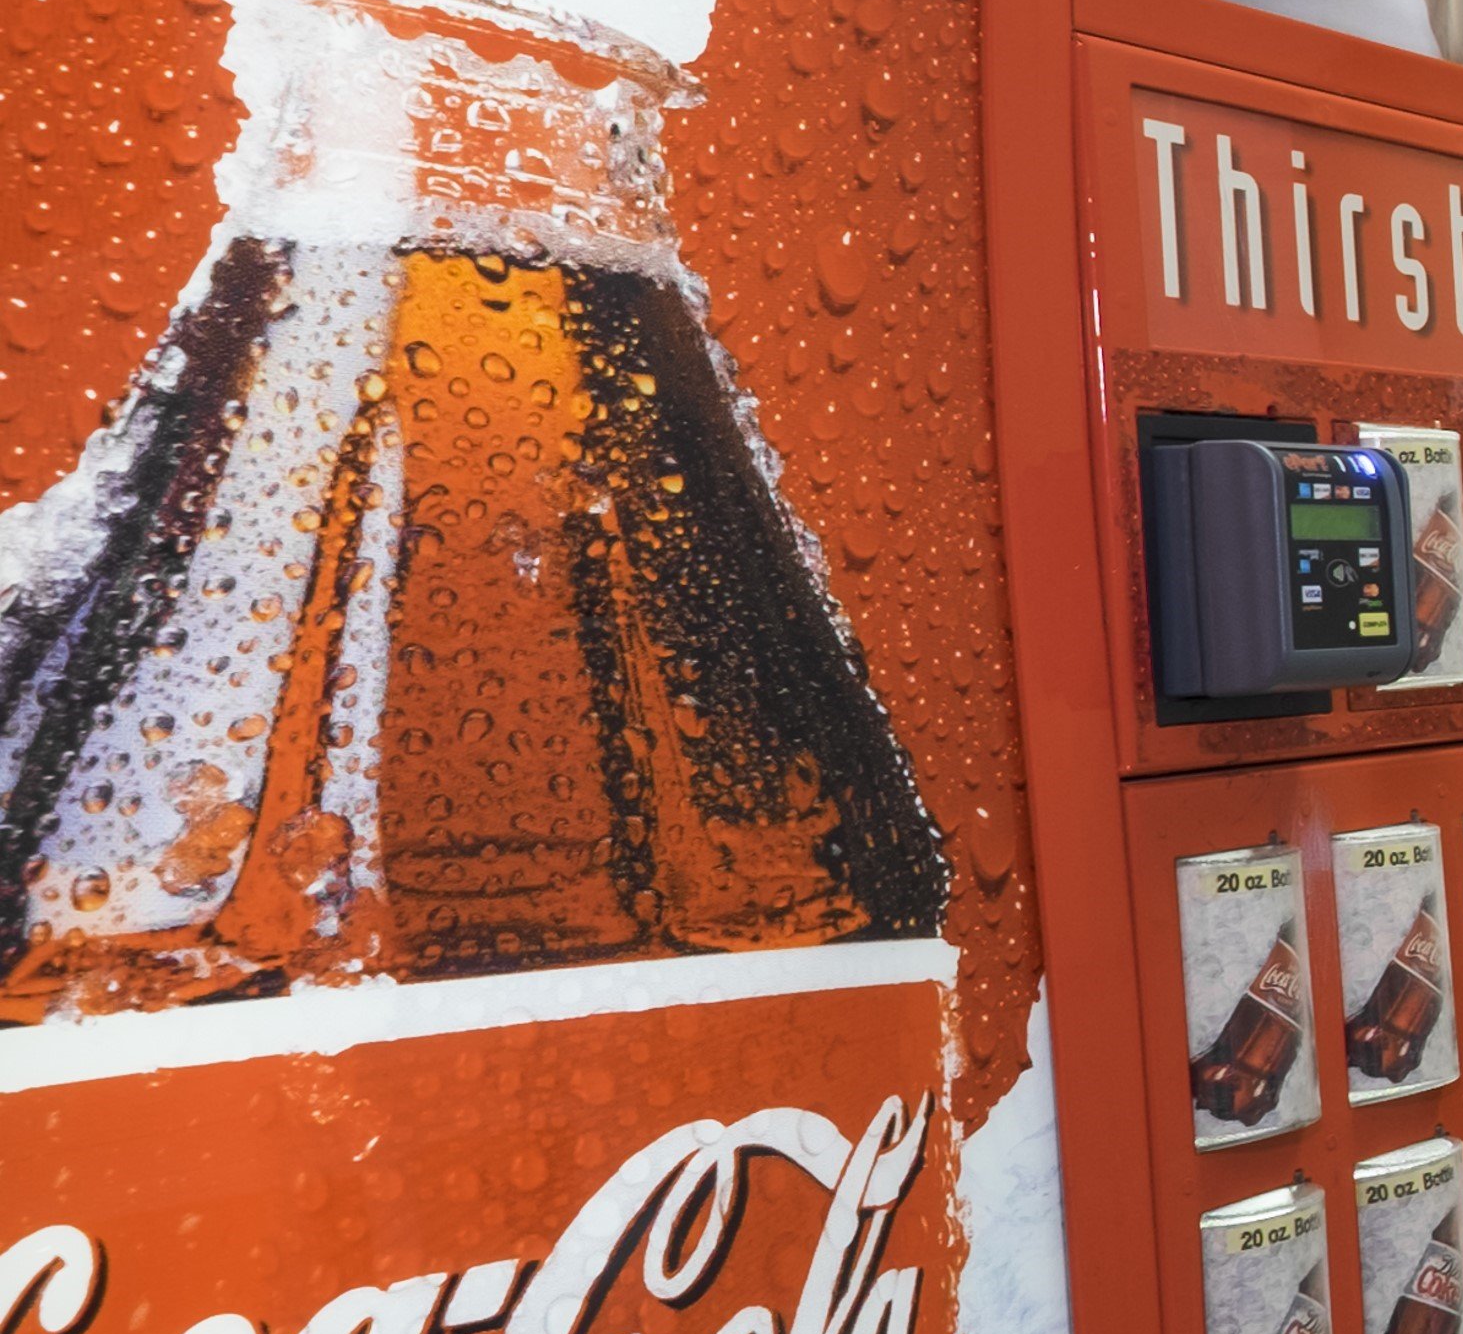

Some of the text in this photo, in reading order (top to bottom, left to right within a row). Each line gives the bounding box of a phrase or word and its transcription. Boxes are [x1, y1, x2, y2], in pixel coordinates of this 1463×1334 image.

[1363, 849, 1385, 868] 20
[1216, 872, 1240, 893] 20
[1365, 1183, 1389, 1205] 20
[1393, 1181, 1420, 1198] oz.
[1240, 1225, 1291, 1251] 20 oz.
